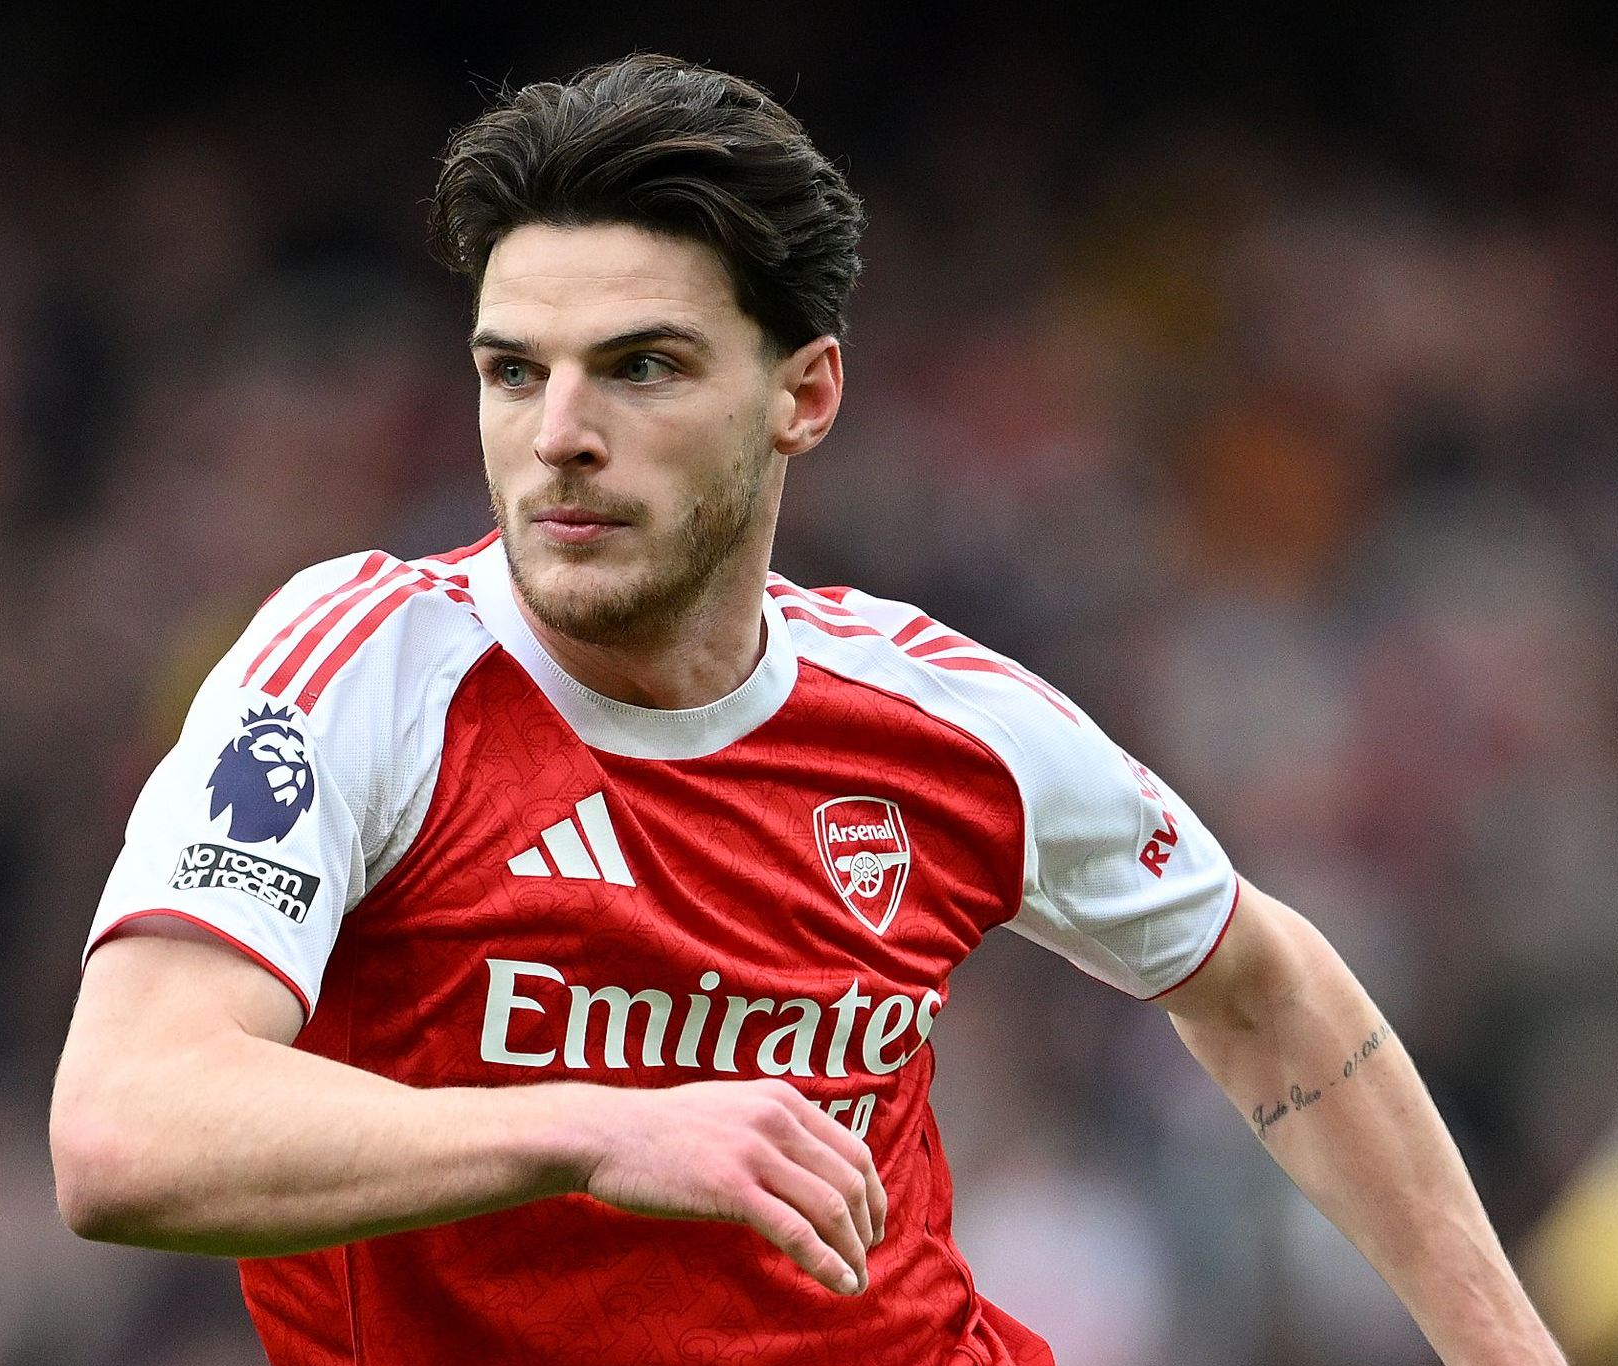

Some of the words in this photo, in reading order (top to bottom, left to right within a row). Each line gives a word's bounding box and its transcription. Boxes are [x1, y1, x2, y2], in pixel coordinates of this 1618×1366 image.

[828, 818, 894, 844] Arsenal
[171, 868, 210, 890] for
[209, 868, 307, 923] racism
[179, 844, 216, 870] No
[218, 850, 303, 896] room
